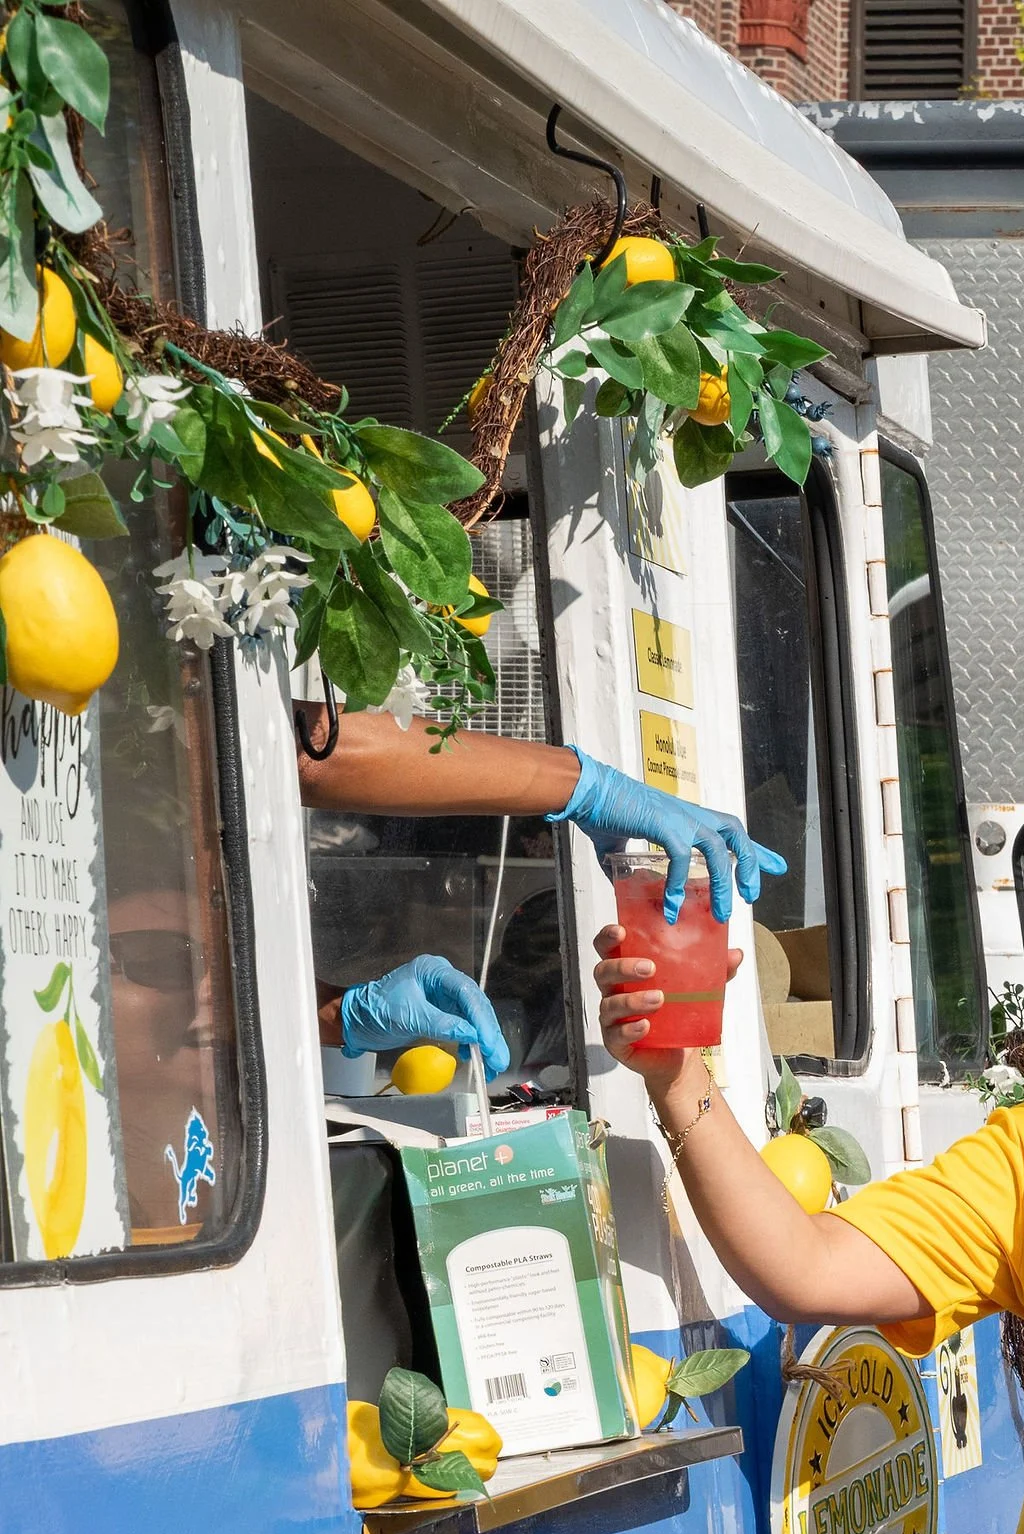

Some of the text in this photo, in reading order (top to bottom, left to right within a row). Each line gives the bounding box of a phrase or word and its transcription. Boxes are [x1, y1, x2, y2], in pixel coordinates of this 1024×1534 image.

[20, 796, 66, 847] AND USE
[14, 852, 80, 904] IT TO MAKE
[9, 907, 87, 958] OTHERS HAPPY
[427, 1151, 488, 1182] planet
[430, 1167, 555, 1197] all green, all the time
[465, 1252, 553, 1273] Compostable PLA Straws
[848, 1359, 893, 1403] COLD
